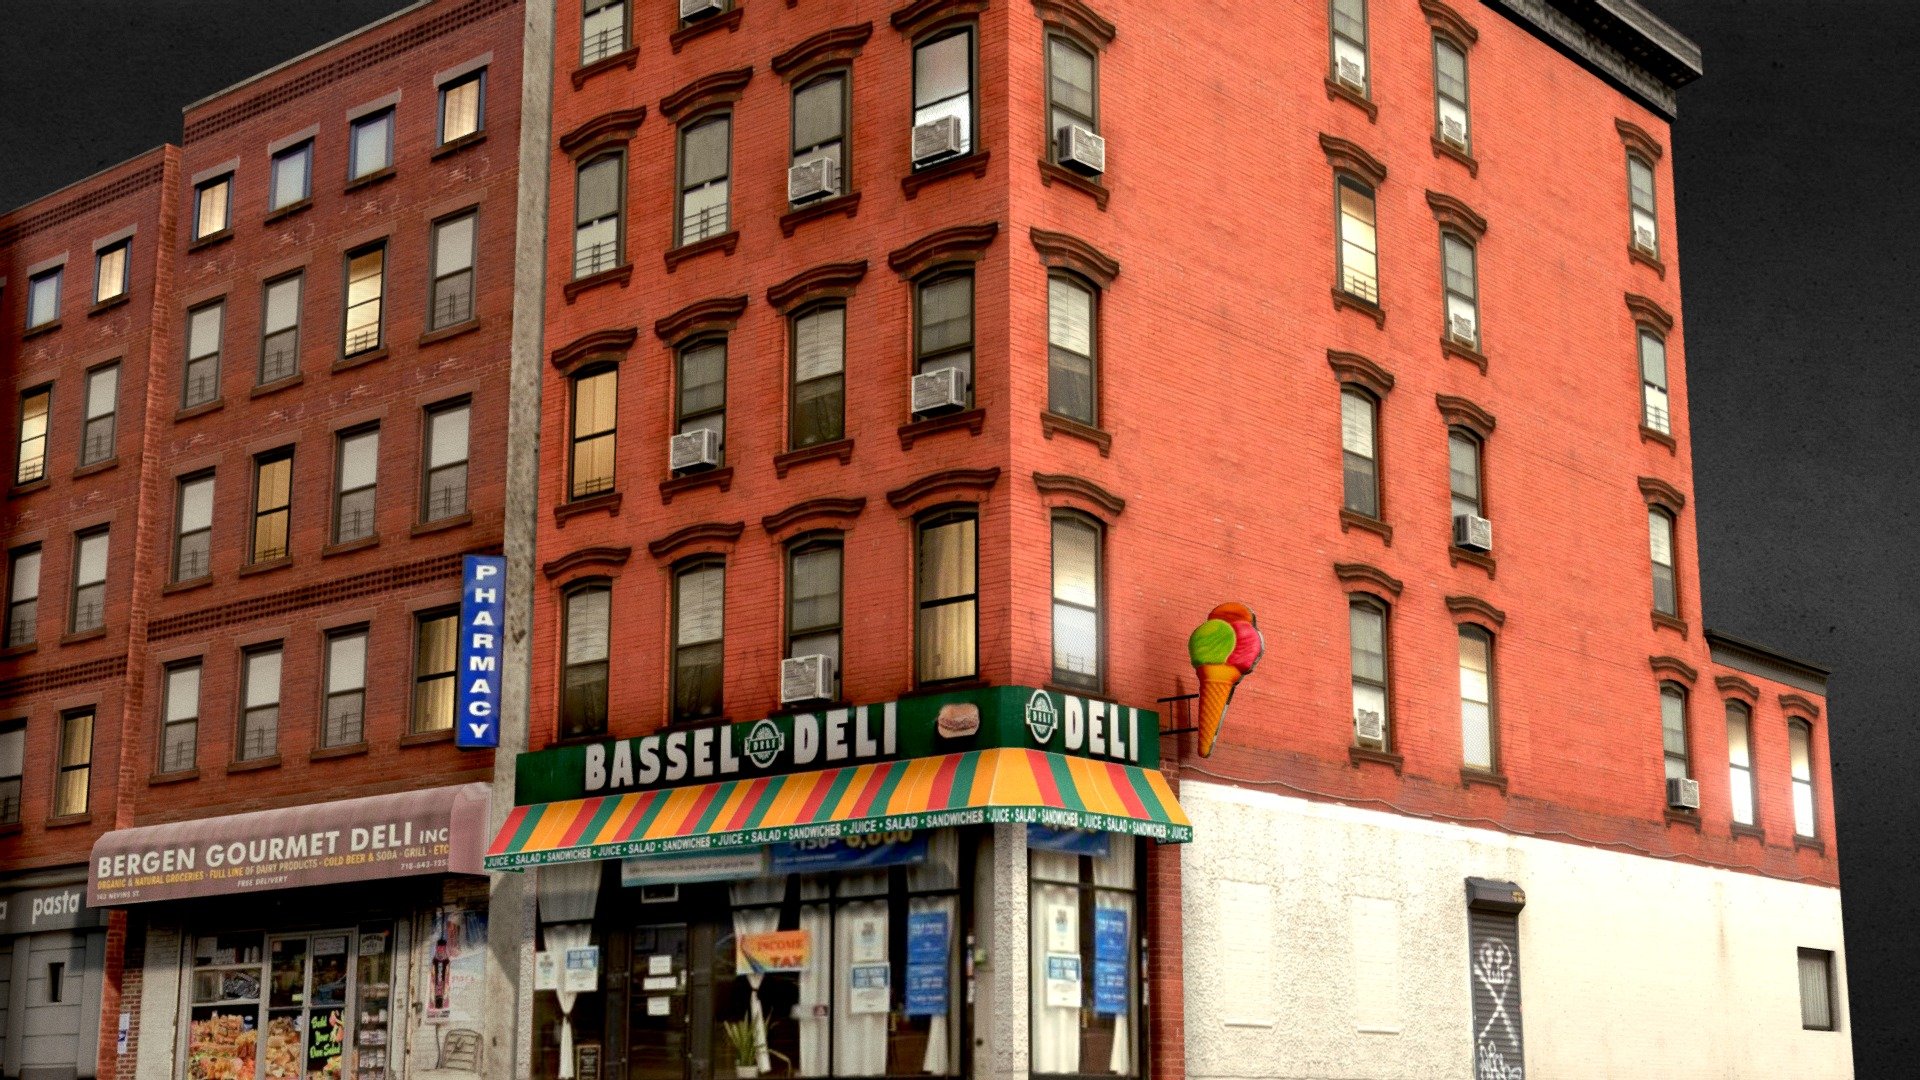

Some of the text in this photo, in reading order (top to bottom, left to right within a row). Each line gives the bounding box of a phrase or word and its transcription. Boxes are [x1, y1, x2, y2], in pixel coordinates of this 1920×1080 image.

[468, 564, 497, 739] PHARMACY
[1033, 710, 1051, 724] DELI
[1064, 694, 1139, 762] DELI
[585, 701, 897, 791] BASSEL DELI
[752, 738, 777, 751] DELI
[487, 810, 984, 868] JUICE SALAD SANDWICHES JUICE SALAD SANDWICHES JUICE SALAD SANDWICHES JUICE SALAD SANDWICHES
[991, 808, 1010, 823] JUICE
[1014, 808, 1036, 823] SALAD
[1041, 809, 1079, 827] SANDWICHES
[1083, 815, 1102, 830] JUICE
[1107, 817, 1128, 833] SALAD
[1132, 821, 1167, 839] SANDWICHES
[1171, 826, 1190, 841] JUICE
[97, 821, 449, 878] BERGEN GOURMET DELI INC
[209, 869, 227, 880] FULL
[280, 859, 318, 872] PRODUCTS
[323, 856, 344, 868] COLD
[345, 853, 366, 866] BEER
[376, 850, 397, 861] SODA
[404, 847, 427, 859] GRILL
[237, 875, 288, 888] FREE DELIVERY
[32, 890, 80, 925] pasta
